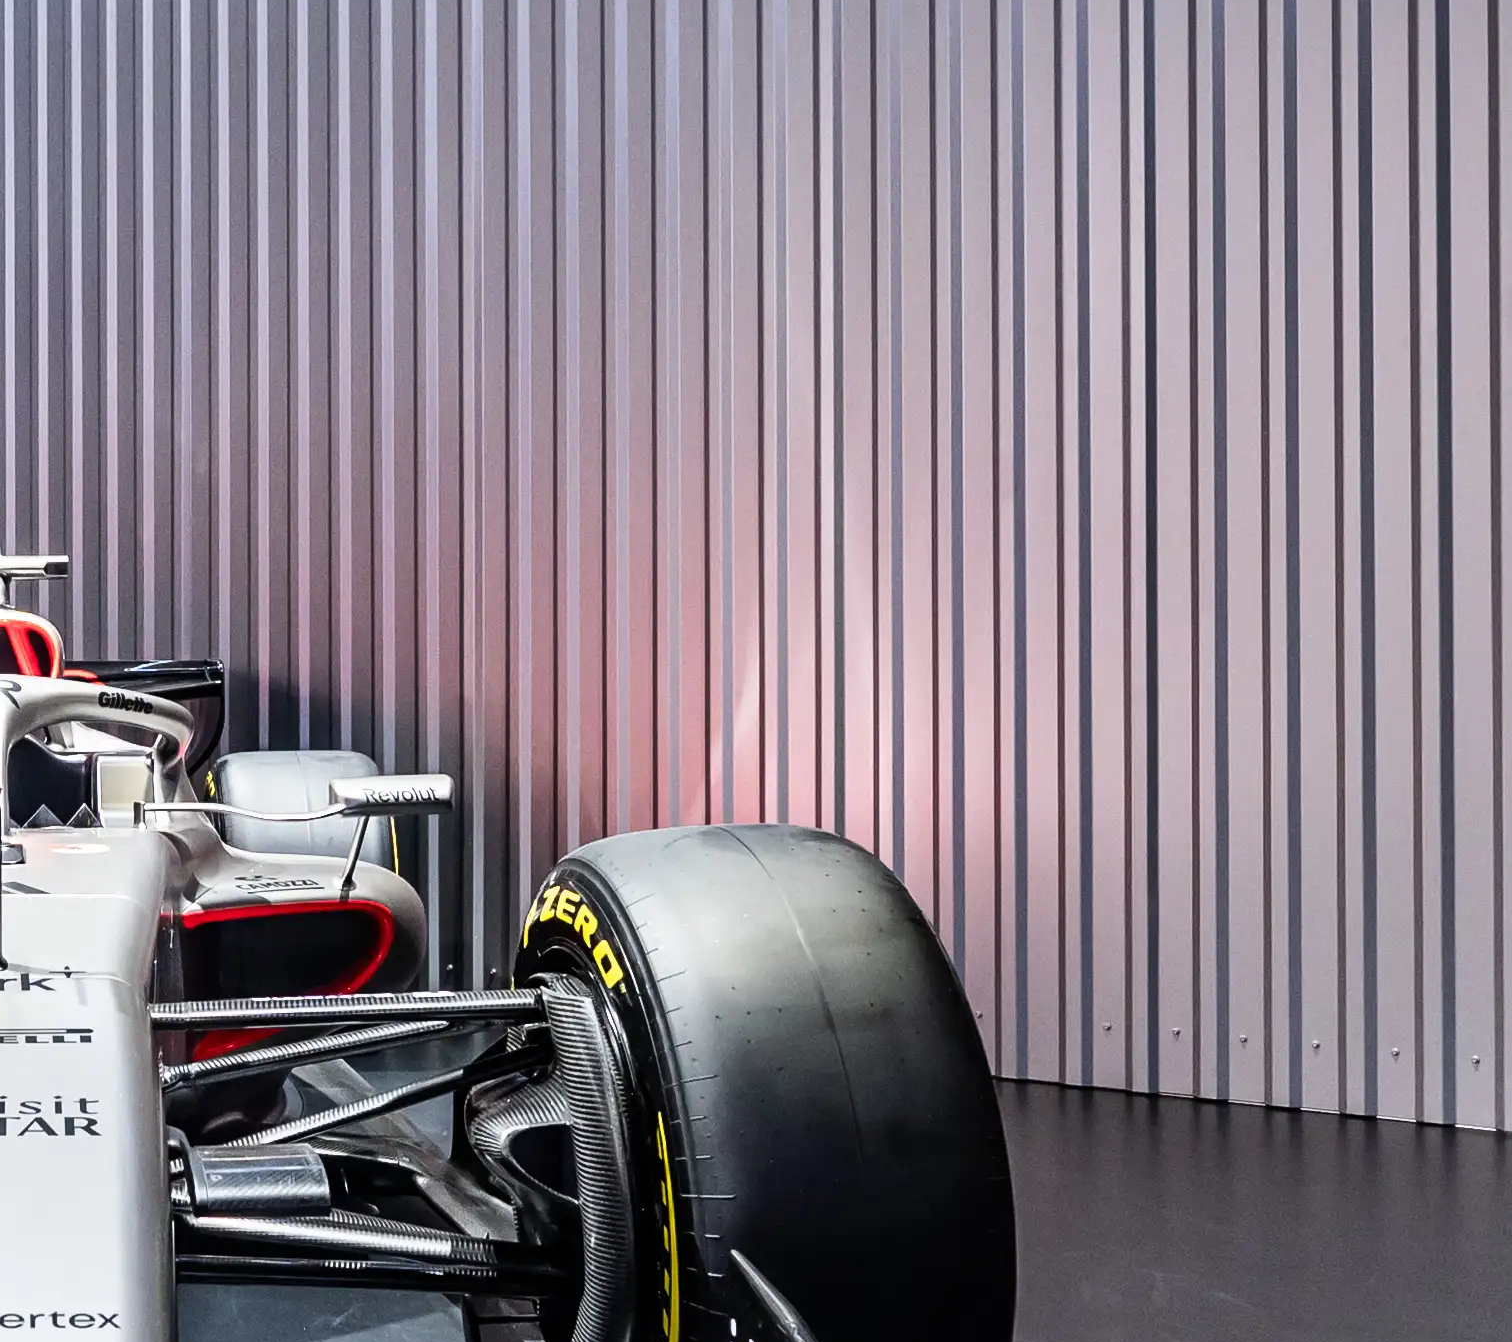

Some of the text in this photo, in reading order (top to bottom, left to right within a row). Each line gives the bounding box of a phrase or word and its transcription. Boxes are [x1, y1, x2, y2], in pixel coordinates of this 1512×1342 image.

[97, 691, 154, 714] Gillette
[361, 787, 440, 803] Revolut
[236, 878, 320, 891] CAMOZZI
[539, 885, 624, 989] ZERO
